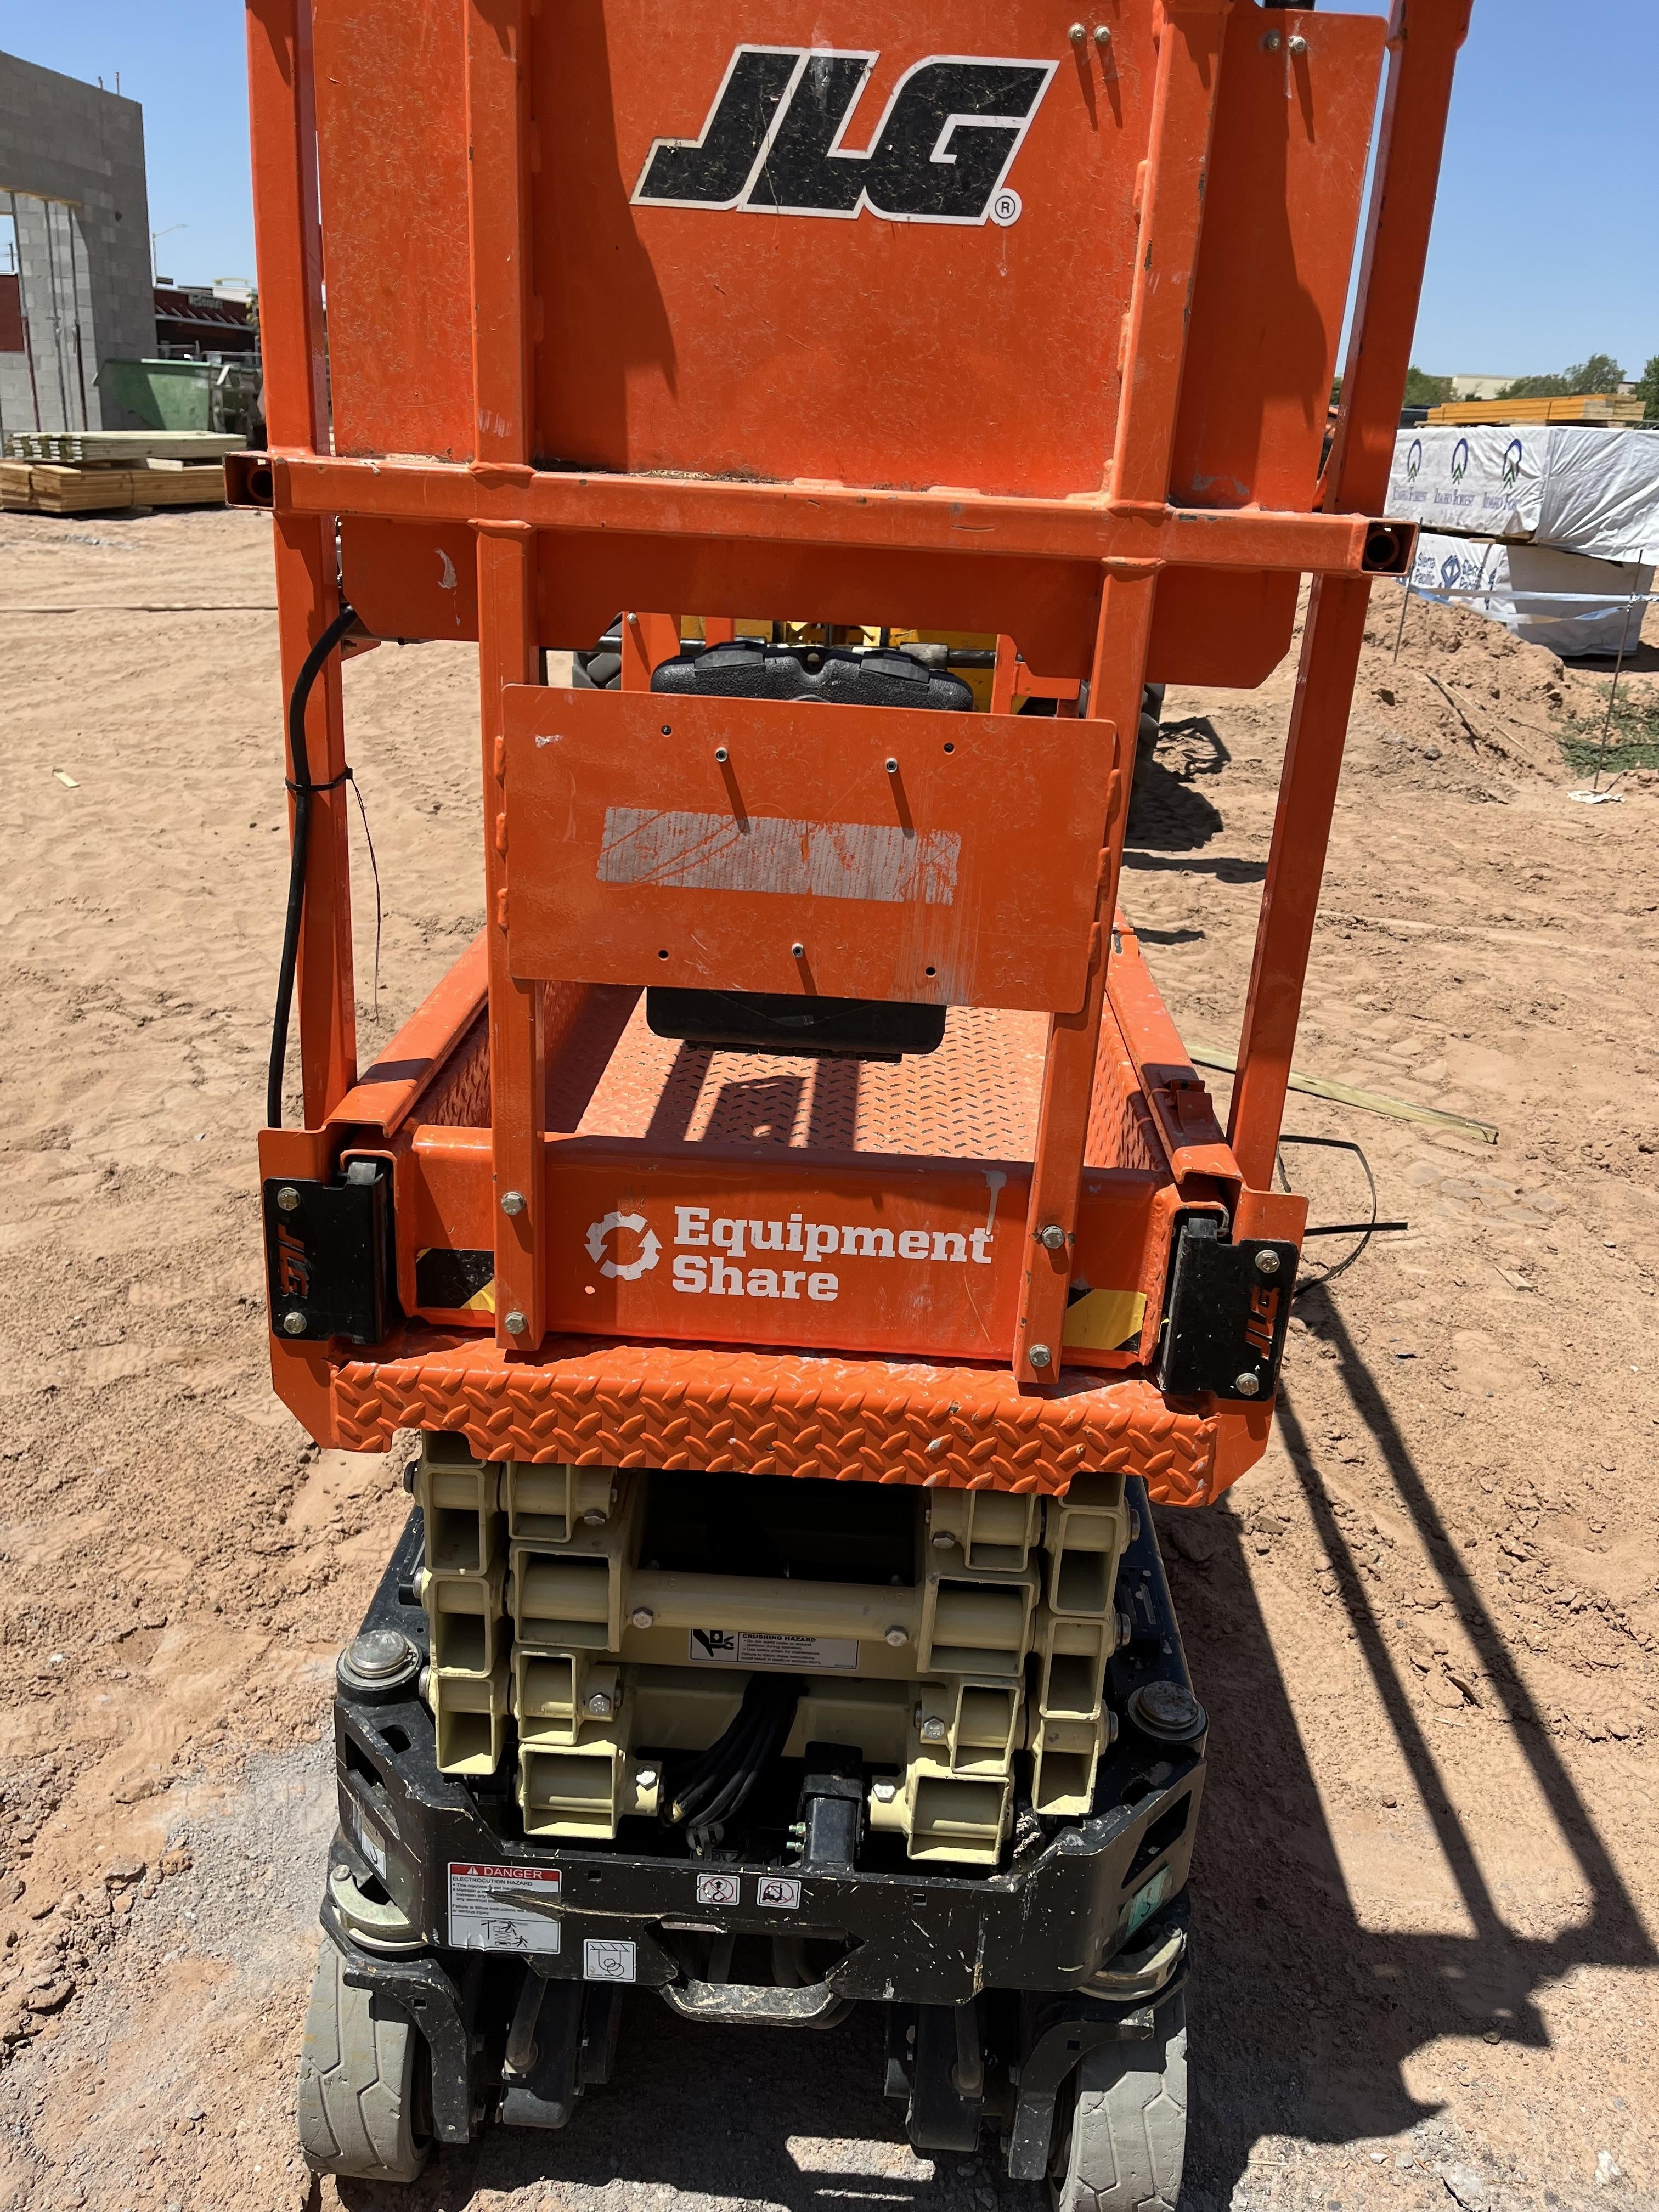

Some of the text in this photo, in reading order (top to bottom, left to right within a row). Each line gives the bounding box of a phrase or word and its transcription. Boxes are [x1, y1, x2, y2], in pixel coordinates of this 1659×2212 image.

[629, 43, 1060, 225] JLG
[674, 1206, 994, 1264] Equipment
[673, 1255, 839, 1301] Share
[1245, 1285, 1281, 1361] JLG
[453, 1876, 505, 1884] ELECTROCUTION
[484, 1867, 543, 1880] DANGER
